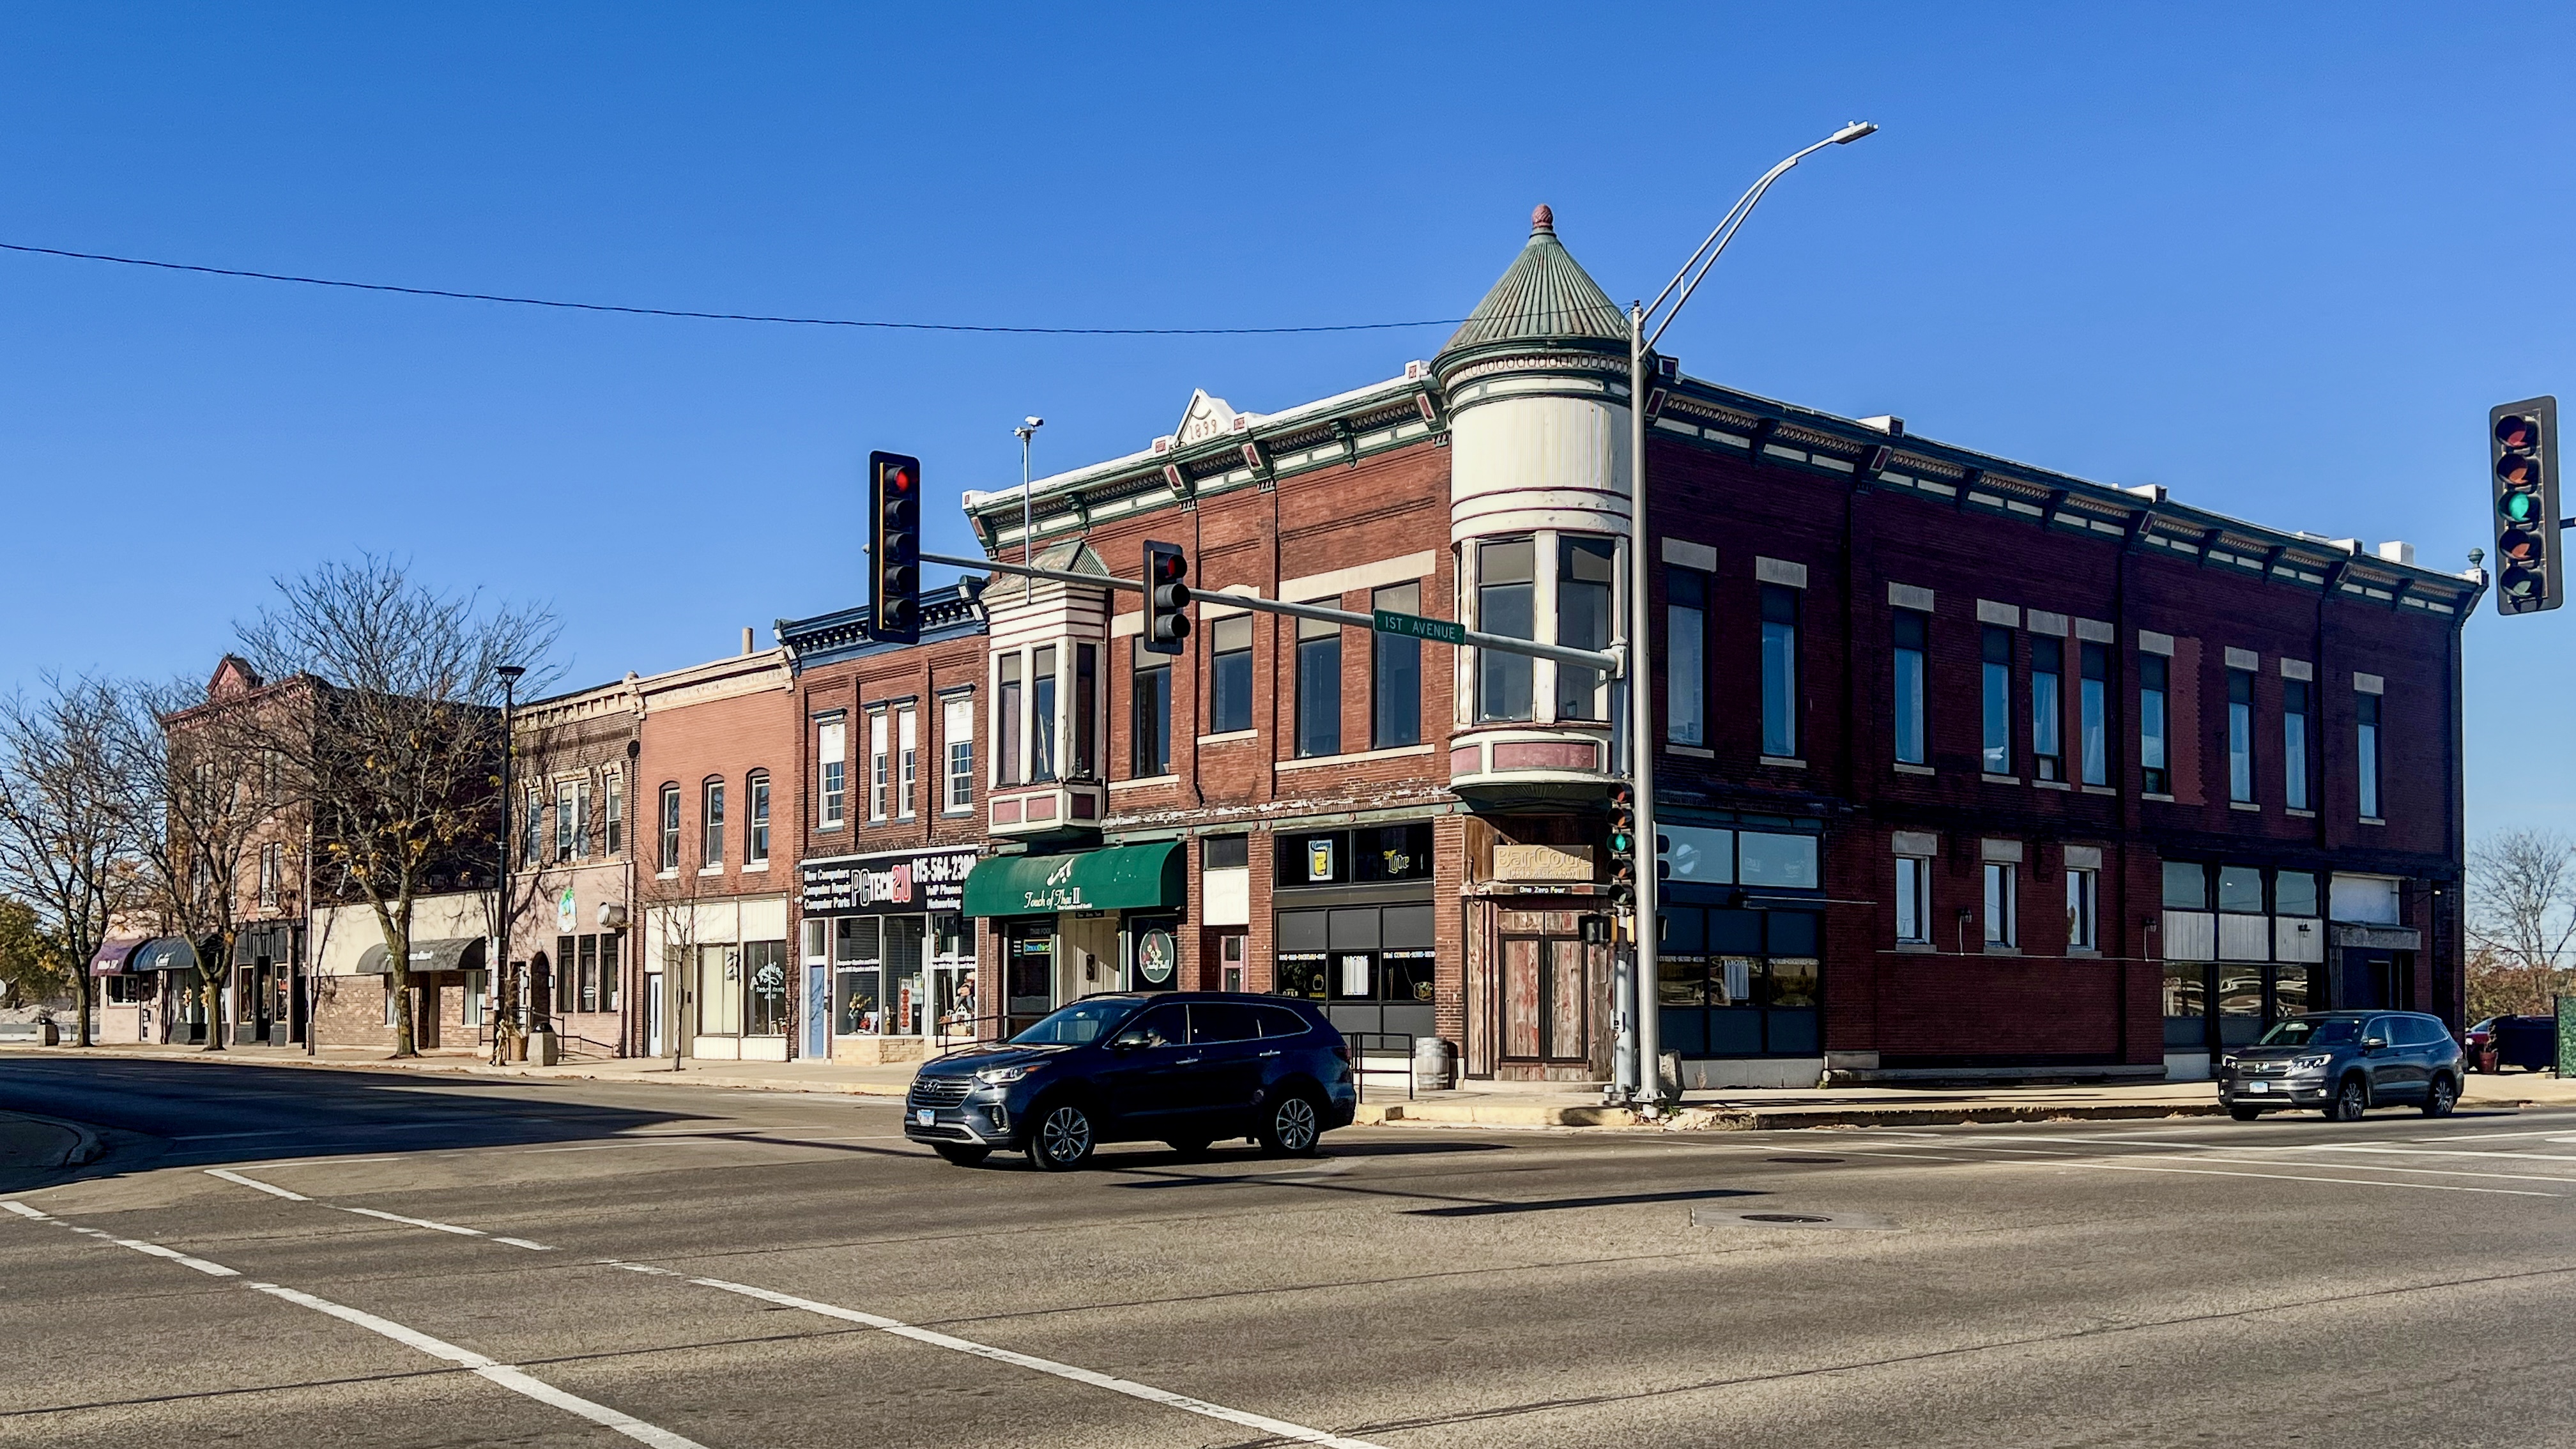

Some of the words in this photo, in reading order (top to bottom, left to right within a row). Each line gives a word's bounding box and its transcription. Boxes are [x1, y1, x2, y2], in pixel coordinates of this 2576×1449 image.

[1190, 419, 1216, 440] 1899
[1385, 616, 1402, 631] 1ST
[1412, 620, 1455, 639] AVENUE
[804, 870, 816, 882] New
[818, 869, 850, 881] Computers
[802, 884, 831, 897] Computer
[831, 882, 852, 895] Repair
[940, 884, 962, 894] Phones
[804, 898, 832, 911] Computer
[833, 897, 850, 908] Parts
[926, 897, 961, 910] Networking
[1023, 889, 1045, 908] Touch
[1046, 889, 1055, 910] of
[1054, 889, 1072, 906] Thai
